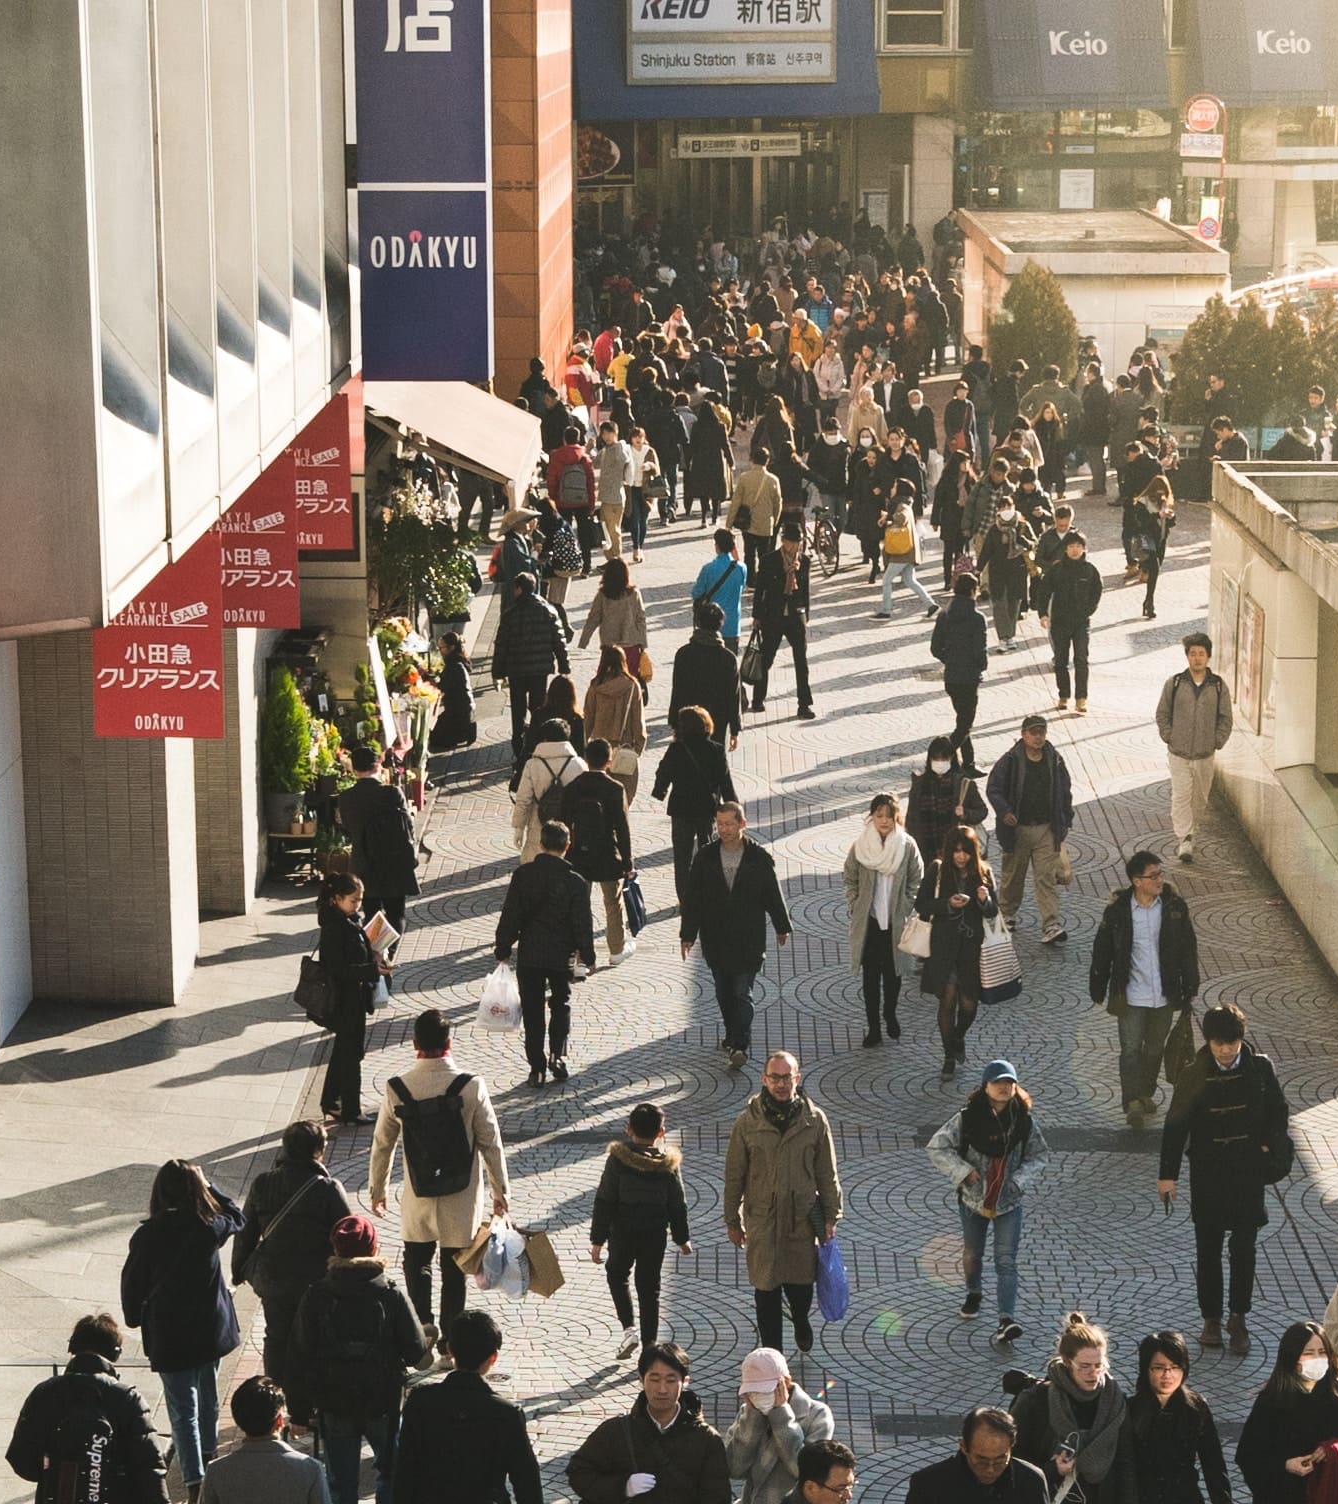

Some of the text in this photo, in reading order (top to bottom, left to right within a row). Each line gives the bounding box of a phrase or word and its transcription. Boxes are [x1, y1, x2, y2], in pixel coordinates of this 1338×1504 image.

[1049, 30, 1108, 56] Keio
[1256, 29, 1312, 55] Keio
[640, 53, 736, 70] Shinjuku Station
[370, 231, 477, 271] ODAKYU
[311, 449, 338, 465] SALE
[295, 479, 329, 495] 田急
[255, 513, 283, 530] SALE
[172, 604, 205, 623] SALE
[223, 608, 266, 623] ODAKYU
[124, 642, 192, 665] 小田急
[96, 667, 221, 690] クリアランス
[134, 713, 184, 731] ODAKYU
